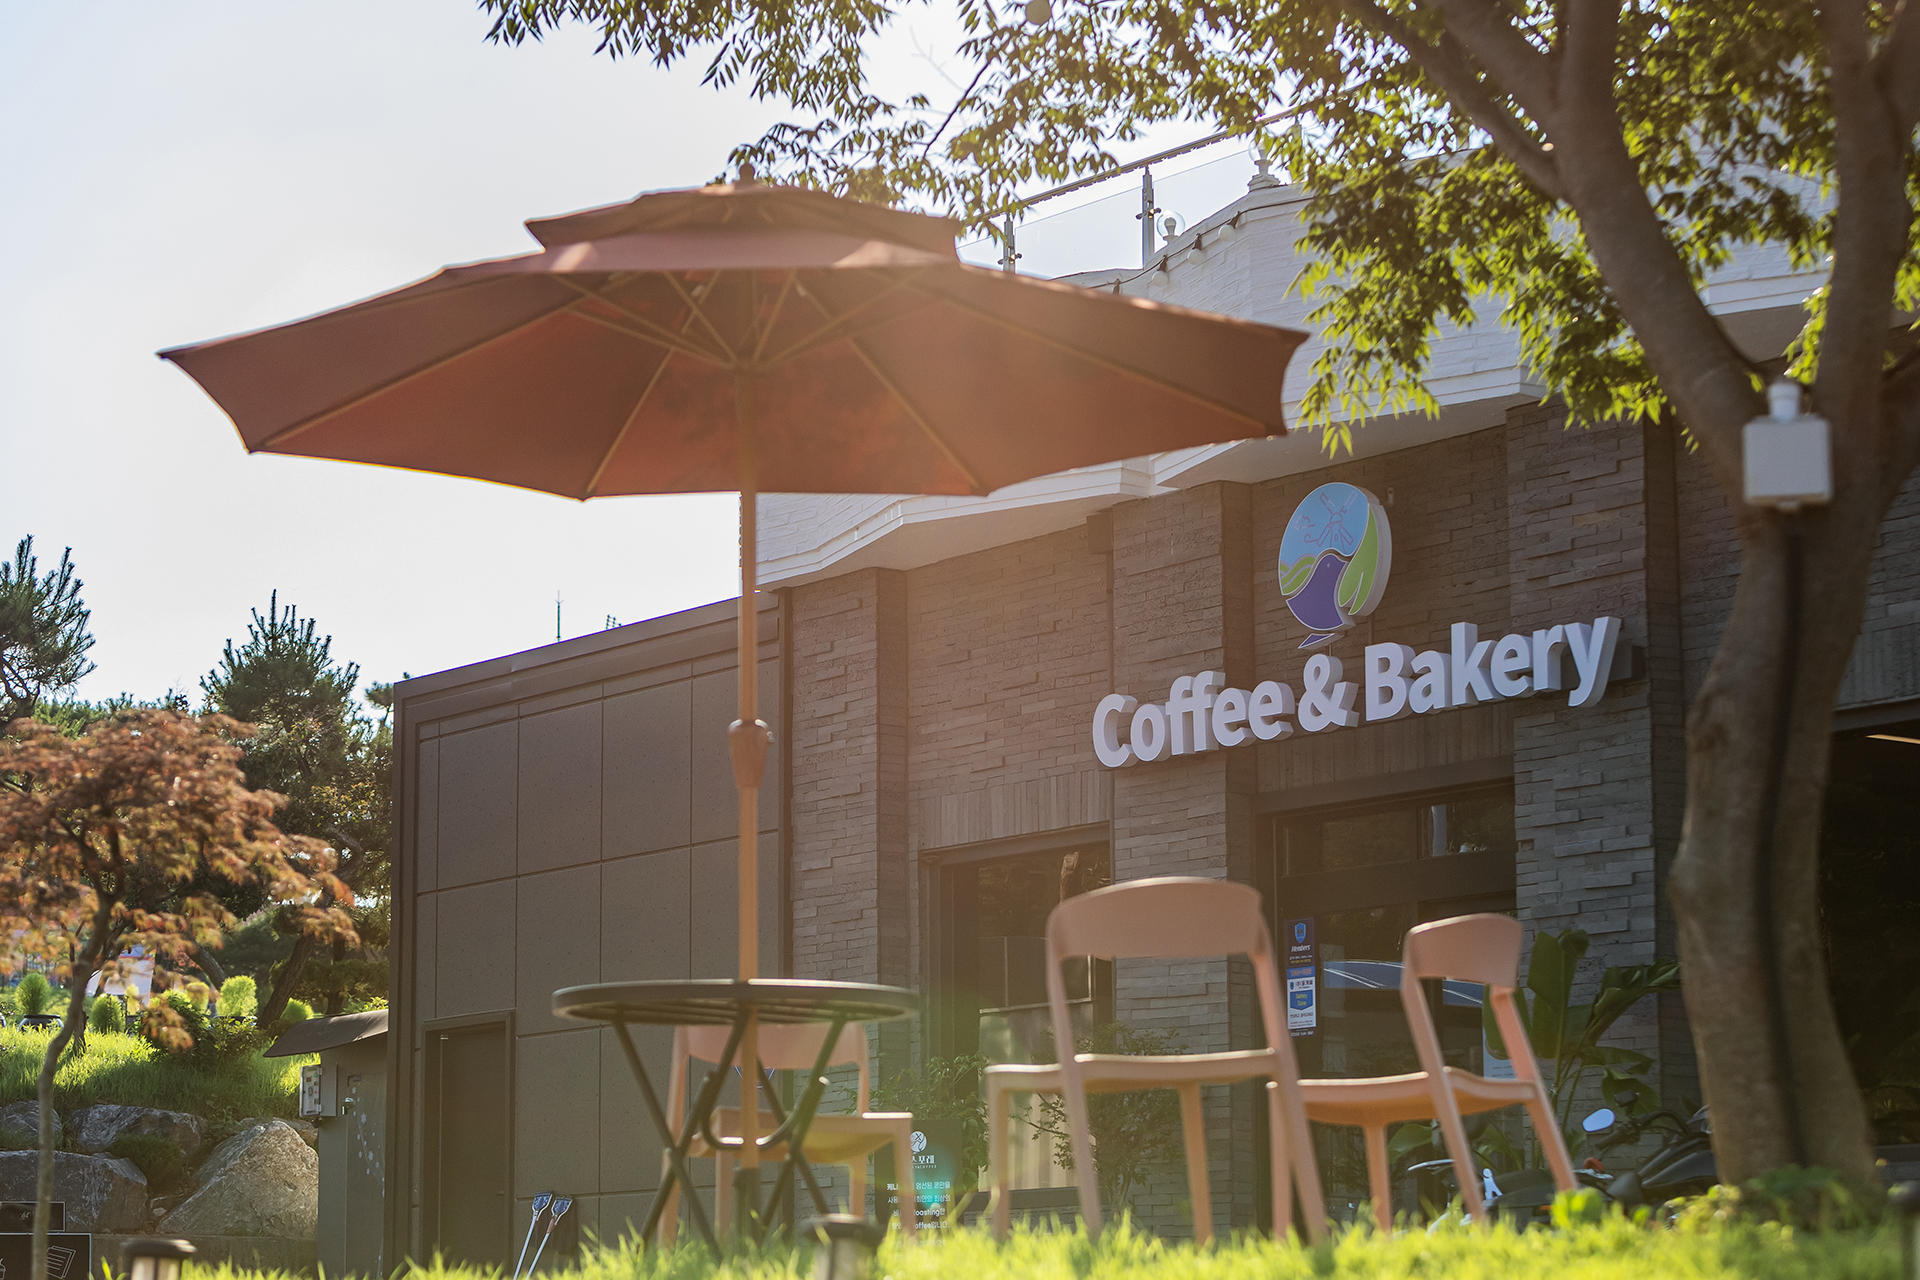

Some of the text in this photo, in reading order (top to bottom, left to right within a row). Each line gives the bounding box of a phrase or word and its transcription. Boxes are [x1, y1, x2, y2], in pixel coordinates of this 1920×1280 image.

[1092, 615, 1622, 768] Coffee & Bakery
